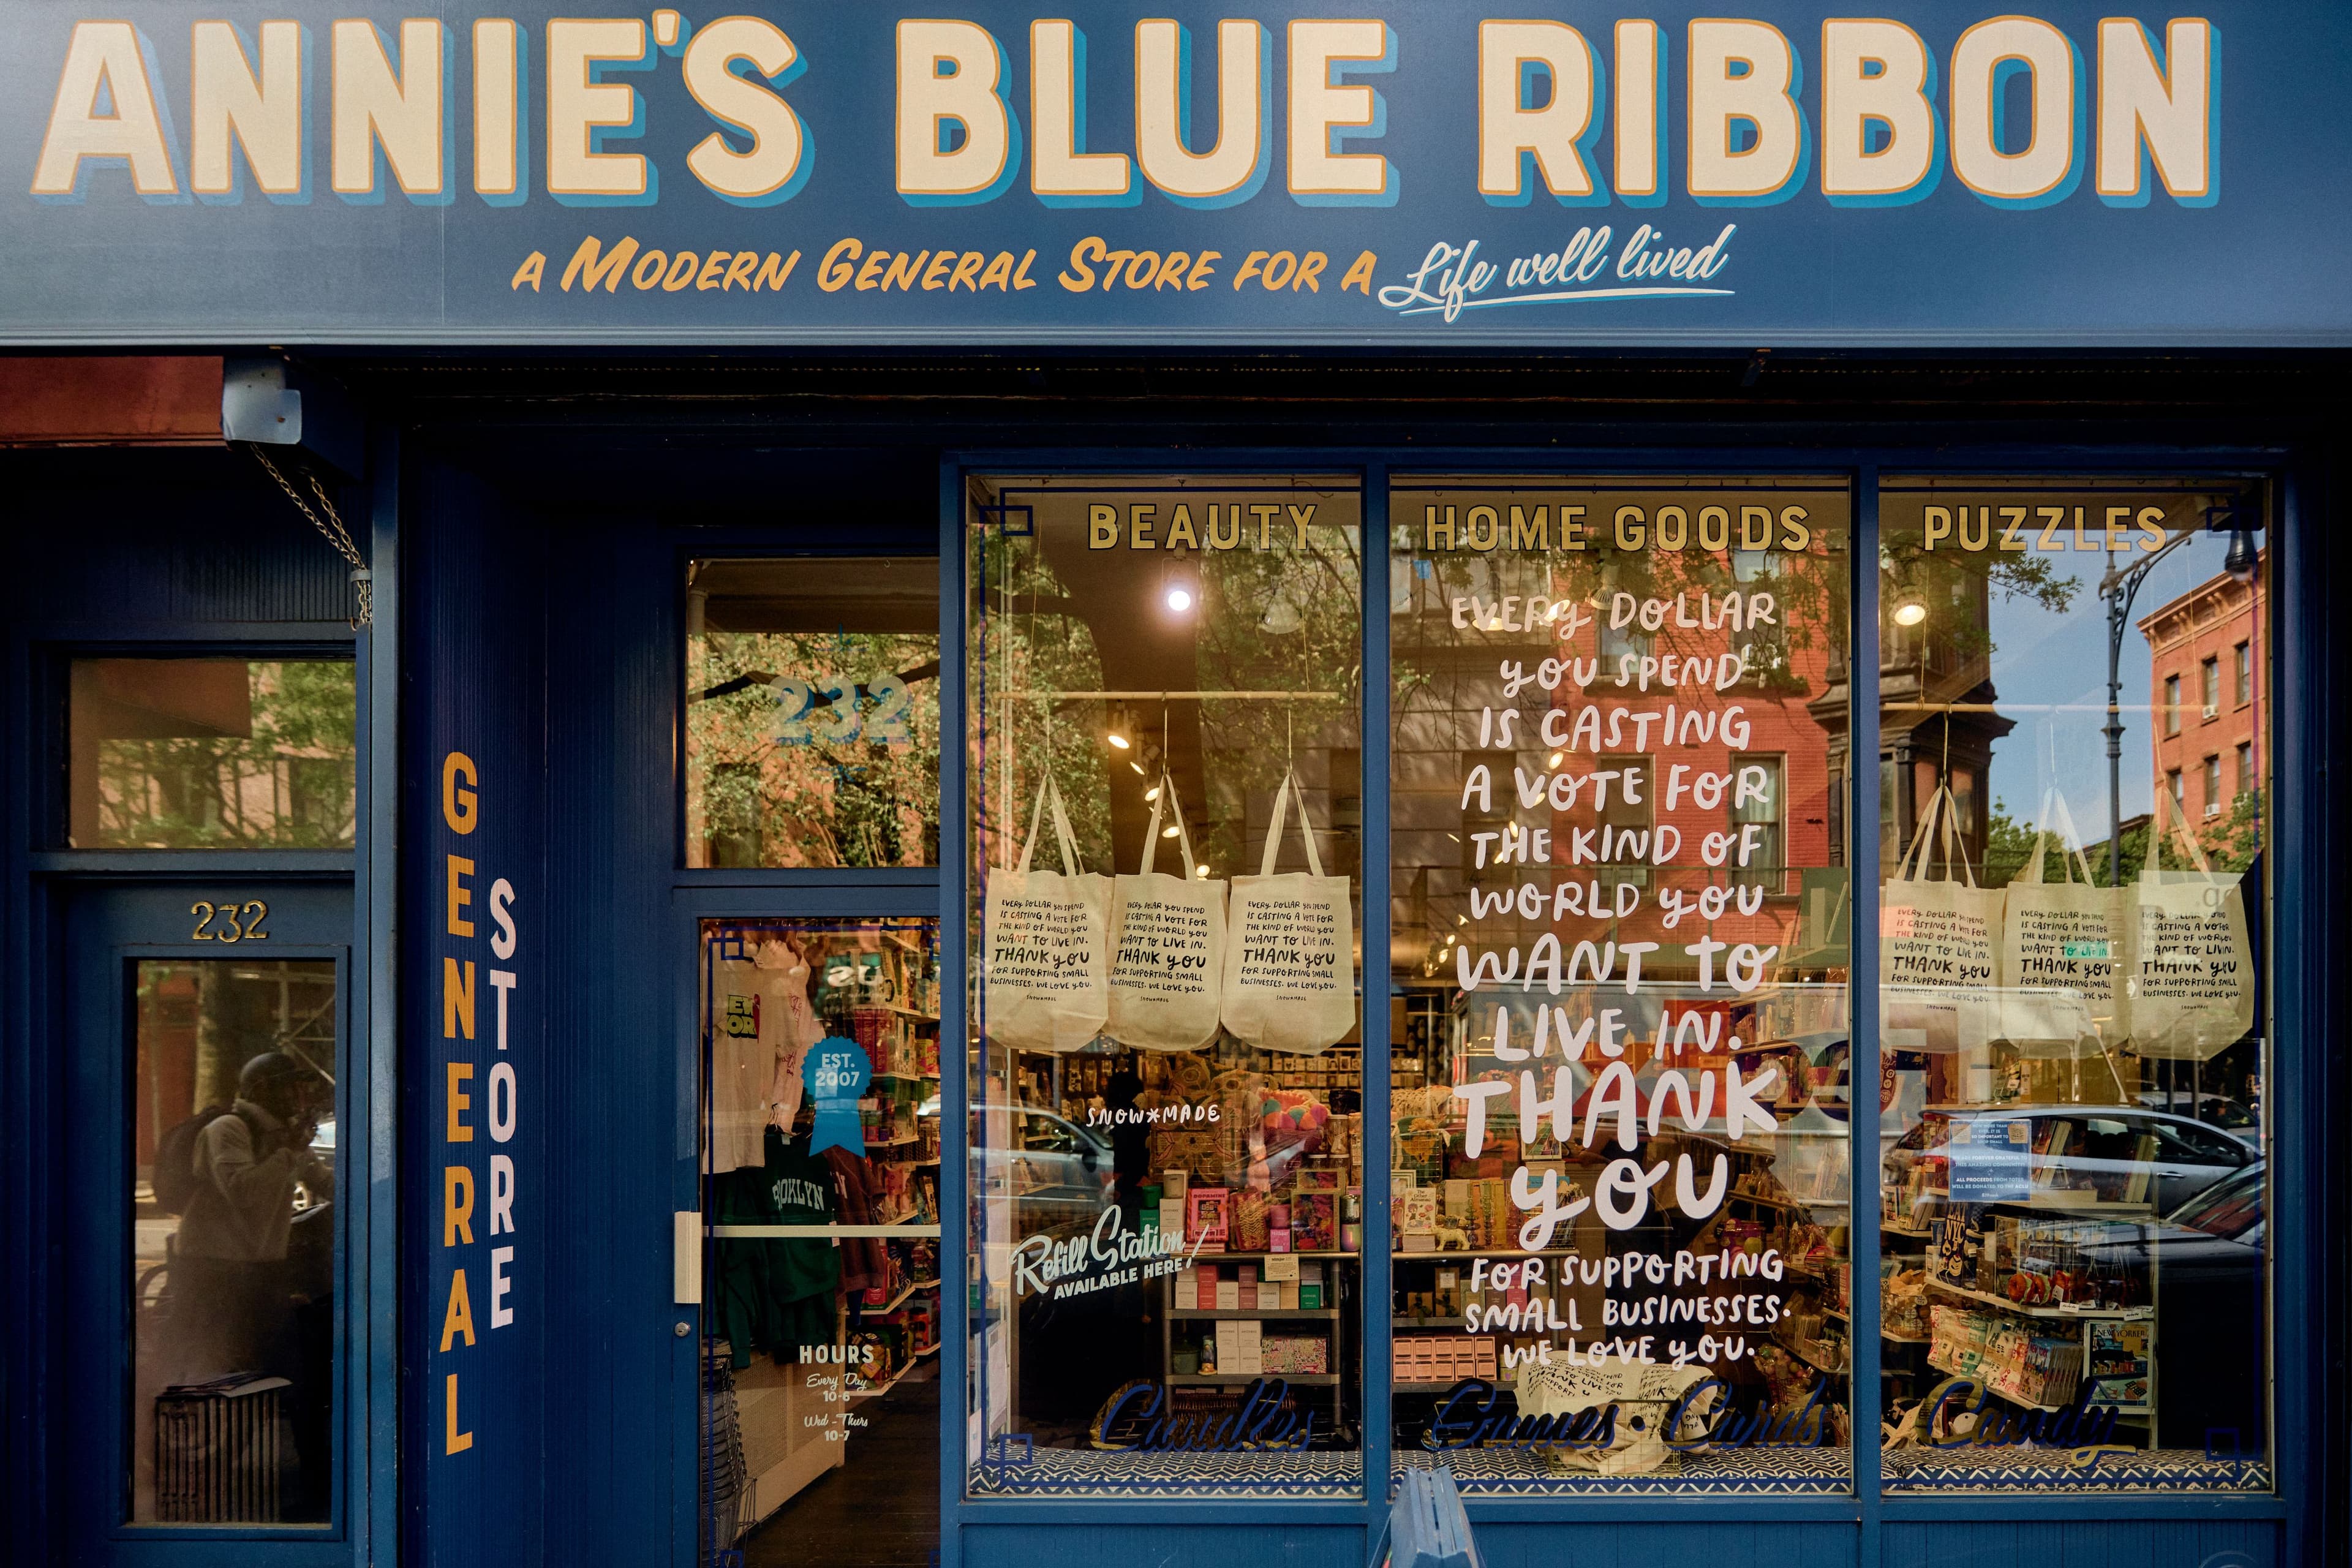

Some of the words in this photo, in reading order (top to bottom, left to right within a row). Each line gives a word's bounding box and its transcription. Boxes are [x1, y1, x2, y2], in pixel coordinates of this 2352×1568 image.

[29, 8, 815, 207] ANNIE'S
[895, 18, 1400, 208] BLUE
[1478, 15, 2221, 209] RIBBON
[511, 251, 543, 293] A
[560, 235, 801, 294] MODERN
[816, 237, 1038, 293] GENERAL
[1058, 236, 1223, 293] STORE
[1233, 250, 1336, 293] FOR
[1341, 250, 1378, 296] A
[1378, 227, 1493, 323] Life
[1506, 226, 1613, 290] well
[1616, 223, 1737, 282] lived
[1088, 503, 1317, 551] BEAUTY
[1425, 505, 1587, 551] HOME
[1613, 505, 1811, 552] GOODS
[1923, 505, 2168, 552] PUZZLES
[1610, 592, 1777, 632] DOLLAR
[1615, 653, 1743, 692] SPEND
[769, 674, 914, 745] 232
[1479, 706, 1520, 748] IS
[1540, 704, 1751, 753] CASTING
[1461, 764, 1491, 813] A
[1513, 767, 1645, 812] VOTE
[1665, 764, 1770, 811] FOR
[1471, 826, 1551, 870] THE
[1572, 824, 1681, 866] KIND
[1701, 824, 1762, 867] OF
[1054, 914, 1067, 922] VOTE
[1071, 914, 1087, 922] FOR
[1064, 903, 1084, 911] SPEND
[1471, 880, 1640, 921] WORLD
[191, 900, 269, 943] 232
[995, 948, 1049, 963] THANK
[997, 933, 1028, 944] WANT
[1052, 937, 1069, 947] LIVE
[1073, 937, 1088, 946] IN.
[1117, 948, 1160, 965] THANK
[1244, 948, 1300, 963] THANK
[1245, 934, 1279, 945] WANT
[1303, 936, 1316, 946] LIVE
[1895, 942, 1931, 953] WANT
[1958, 947, 1971, 959] LIVE
[1011, 967, 1059, 978] SUPPORTING
[1062, 969, 1088, 978] SMALL
[1129, 968, 1172, 979] SUPPORTING
[1176, 973, 1202, 981] SMALL
[1262, 968, 1310, 977] SUPPORTING
[1457, 933, 1659, 995] WANT
[1685, 935, 1777, 992] TO
[1894, 956, 1953, 973] THANK
[2021, 957, 2078, 974] THANK
[990, 978, 1033, 987] BUSINESSES.
[1494, 1003, 1626, 1061] LIVE
[1654, 1009, 1742, 1060] IN.
[815, 1072, 860, 1086] 2007
[821, 1054, 855, 1068] EST.
[440, 752, 477, 1456] GENERAL
[488, 878, 516, 1329] STORE
[1453, 1060, 1779, 1159] THANK
[1009, 1234, 1088, 1295] Refill
[1091, 1204, 1186, 1271] Station
[1054, 1268, 1138, 1300] AVAILABLE
[1471, 1257, 1545, 1293] FOR
[1561, 1249, 1784, 1287] SUPPORTING
[1465, 1298, 1583, 1334] SMALL
[1602, 1294, 1791, 1327] BUSINESSES.
[799, 1345, 874, 1363] HOURS
[1503, 1340, 1553, 1369] WE
[1568, 1335, 1656, 1367] LOVE
[807, 1374, 838, 1390] Every
[843, 1373, 867, 1392] Day
[823, 1391, 850, 1401] 10-6
[804, 1414, 828, 1427] Wed
[1090, 1378, 1314, 1455] Candles
[1915, 1376, 2136, 1470] Candy
[825, 1430, 850, 1441] 10-7
